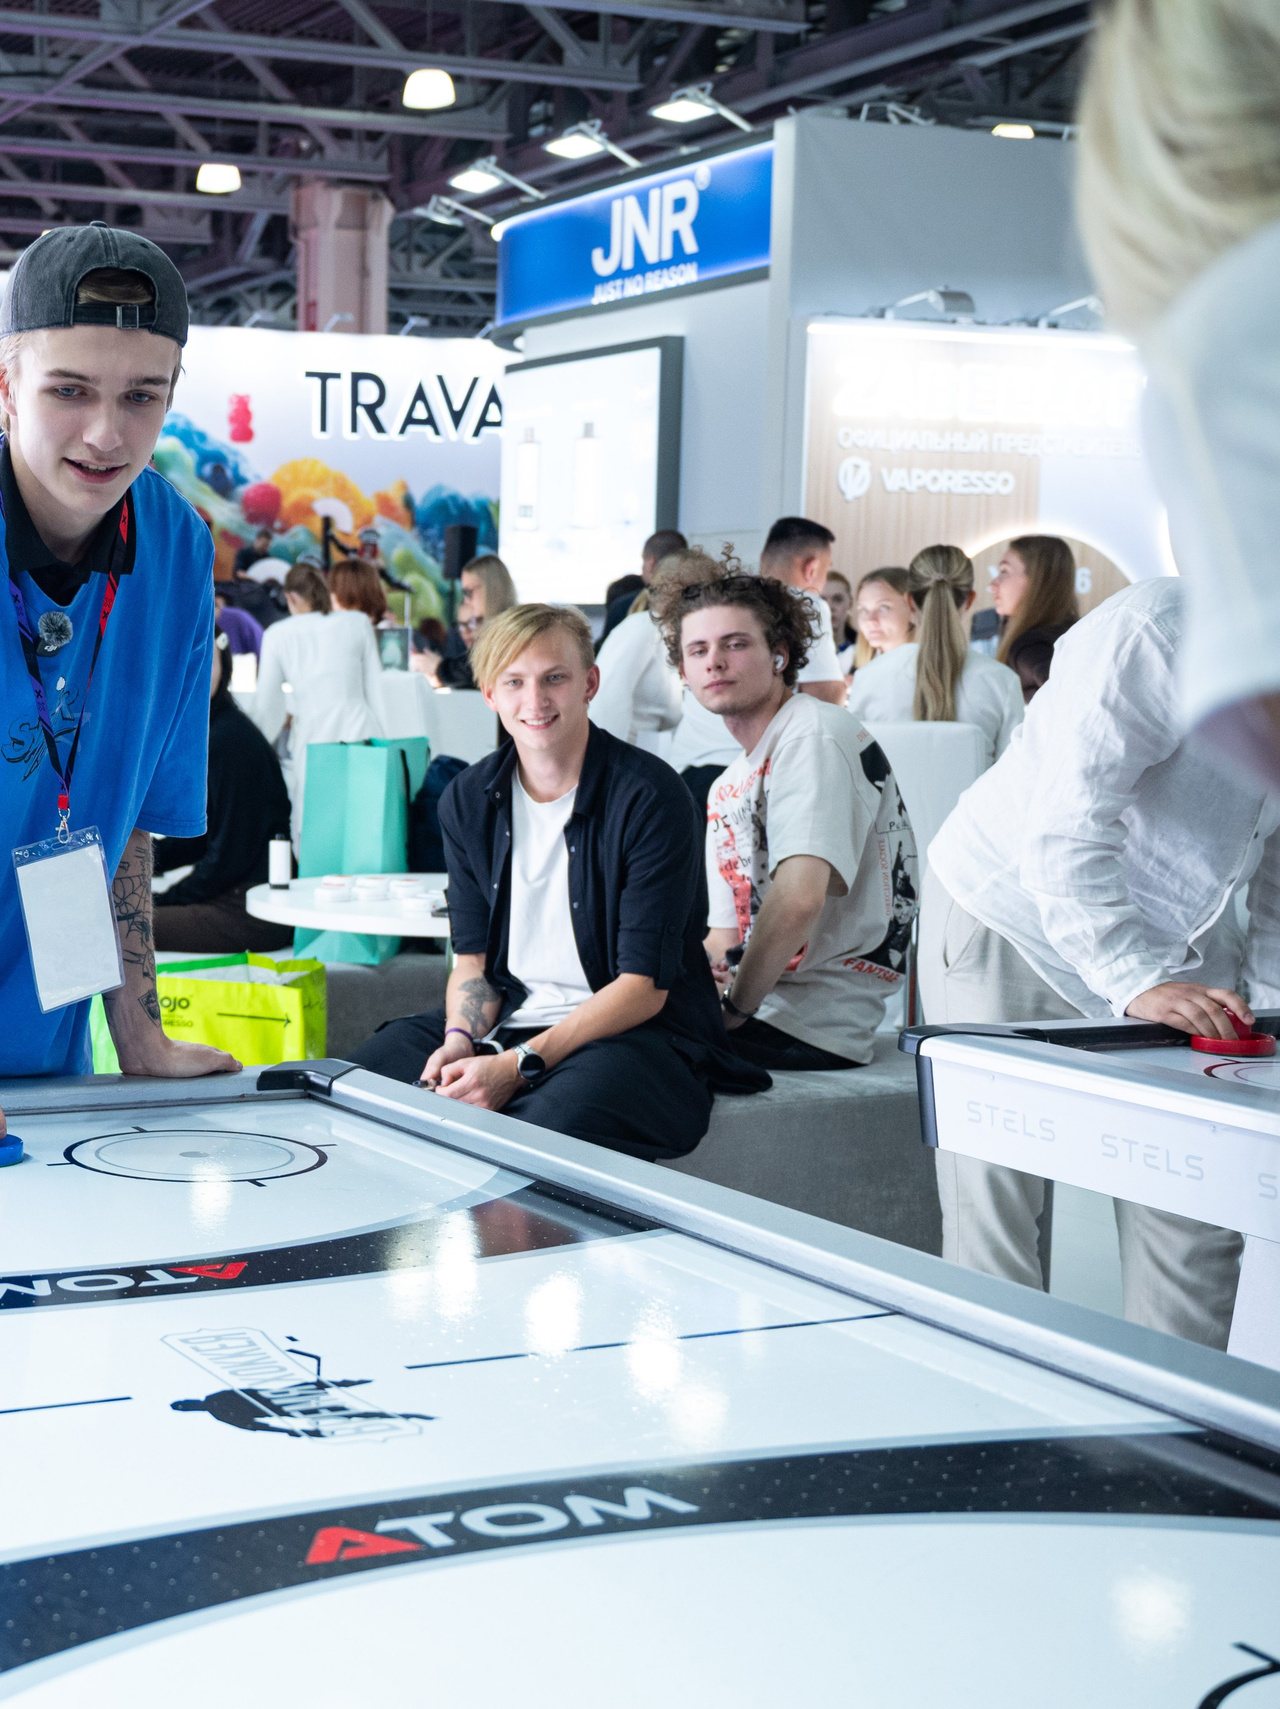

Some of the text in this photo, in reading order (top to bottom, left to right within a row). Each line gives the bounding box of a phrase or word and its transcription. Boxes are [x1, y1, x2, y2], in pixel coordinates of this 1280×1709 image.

[591, 179, 700, 277] JNR
[591, 261, 699, 305] JUST NO REASON
[837, 426, 988, 454] ОФИЦИАЛЬНЫЙ
[880, 466, 1016, 496] VAPORESSO
[966, 1100, 1057, 1143] STELS
[1100, 1133, 1206, 1182] STELS
[305, 1486, 701, 1566] ATOM
